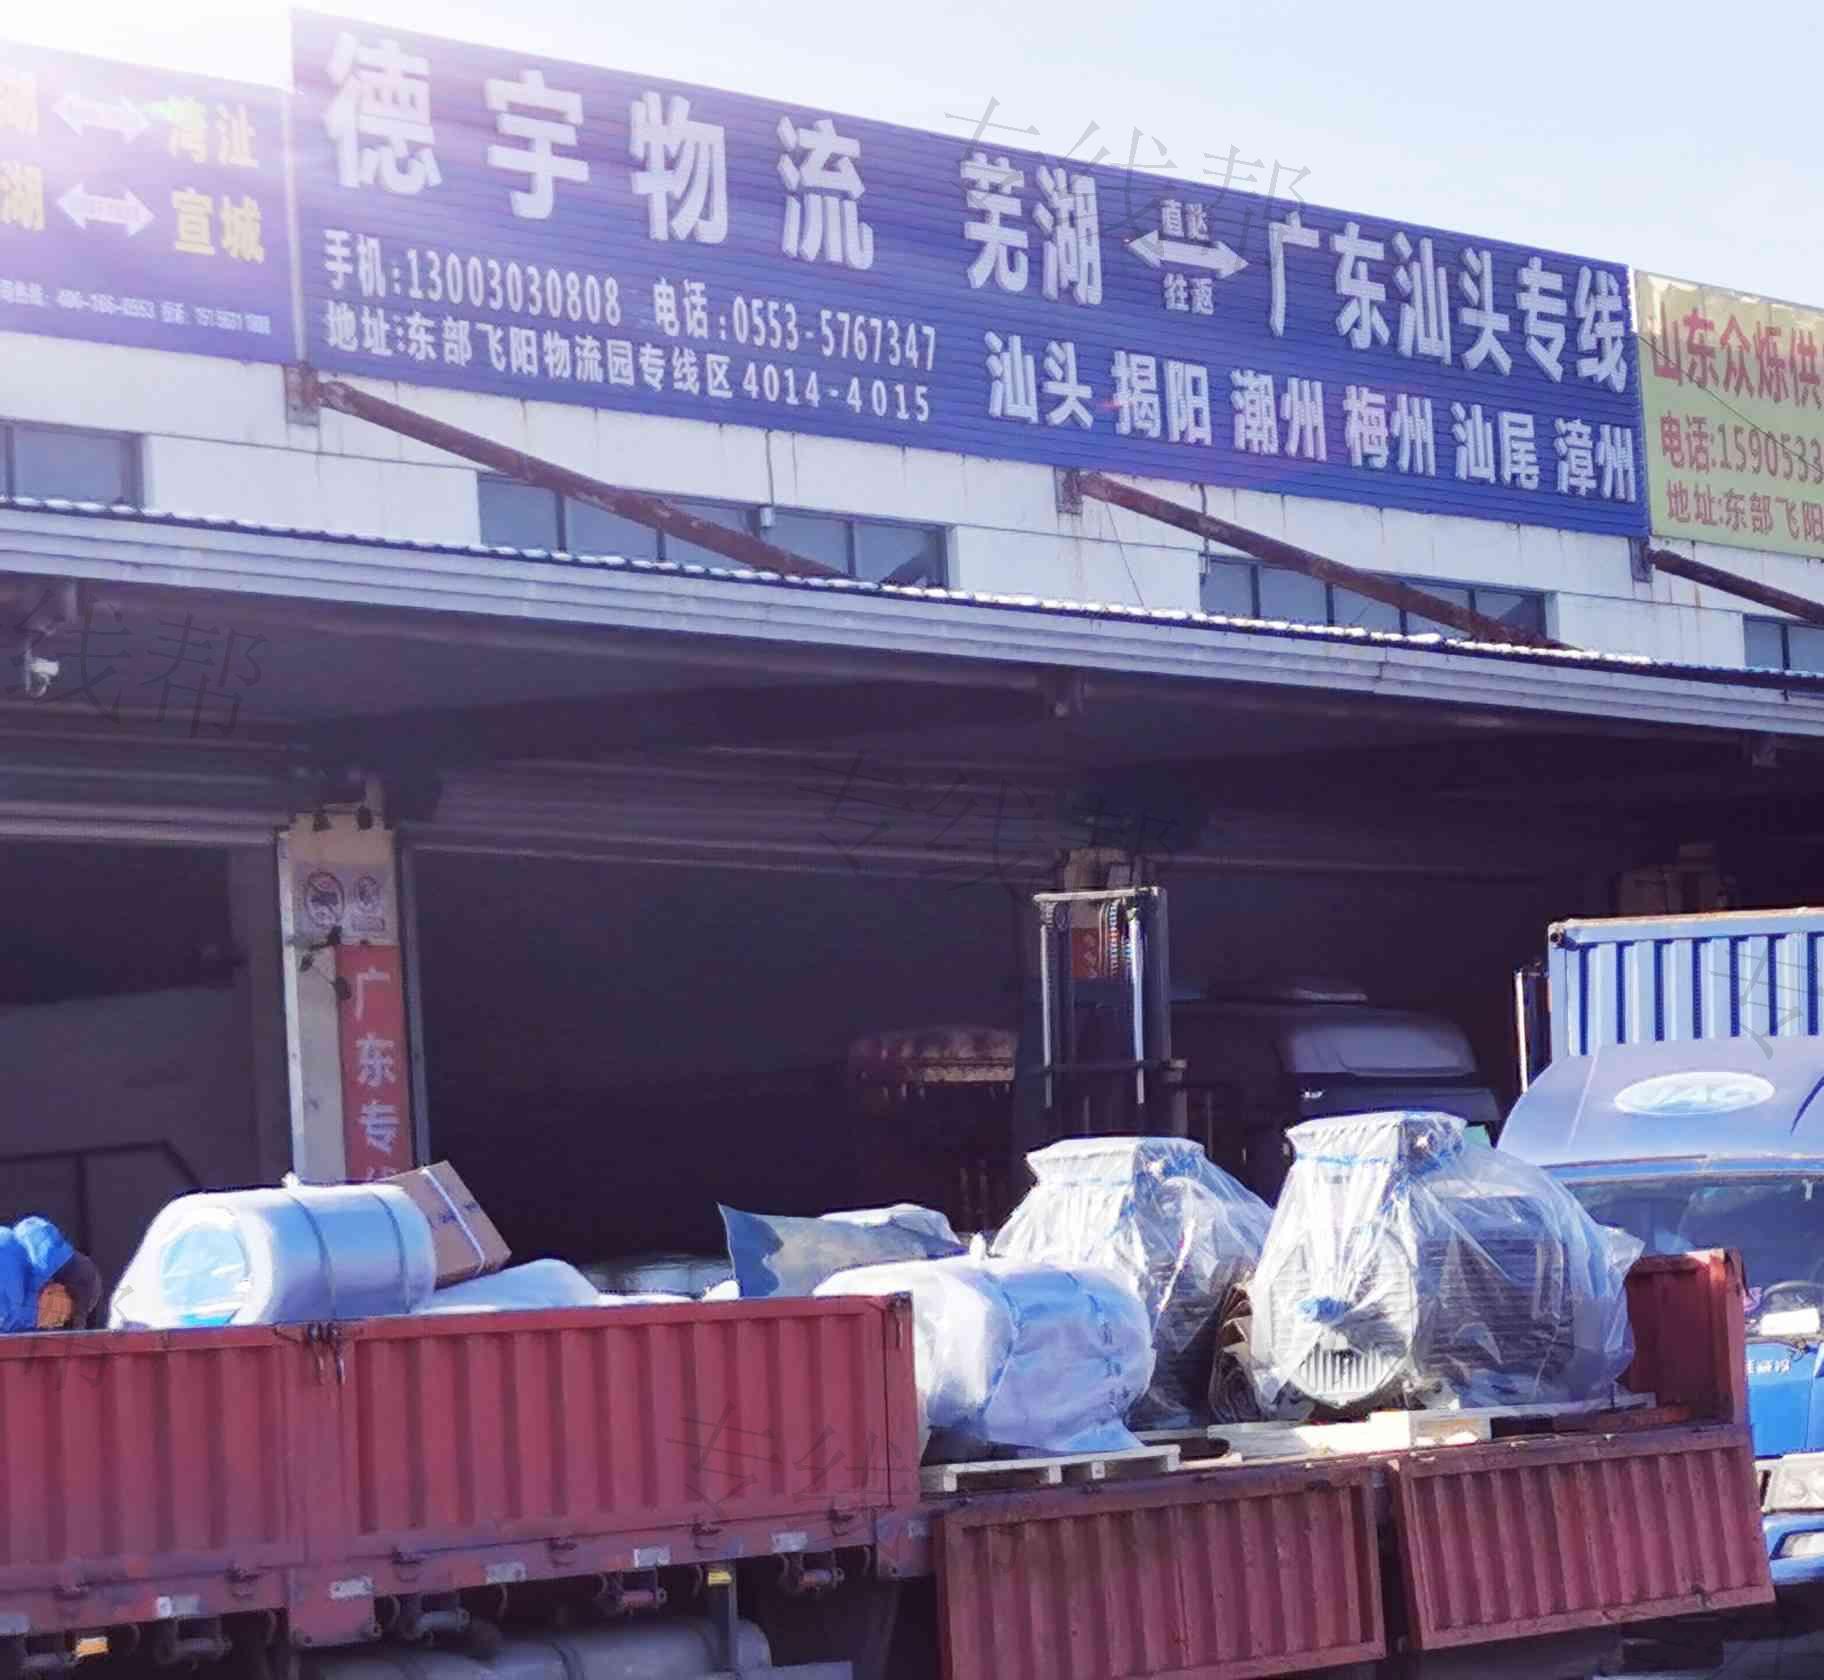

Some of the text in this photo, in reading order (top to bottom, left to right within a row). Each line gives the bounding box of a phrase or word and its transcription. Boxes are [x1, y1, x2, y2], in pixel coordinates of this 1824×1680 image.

[324, 32, 876, 272] 德宇物流
[323, 228, 623, 328] 手机:13003030808
[653, 277, 936, 372] 电话:0553-5767347
[960, 152, 1628, 393] 芜湖 广东汕头专线
[984, 331, 1636, 502] 汕头 揭阳 潮州 梅州 汕尾 漳州
